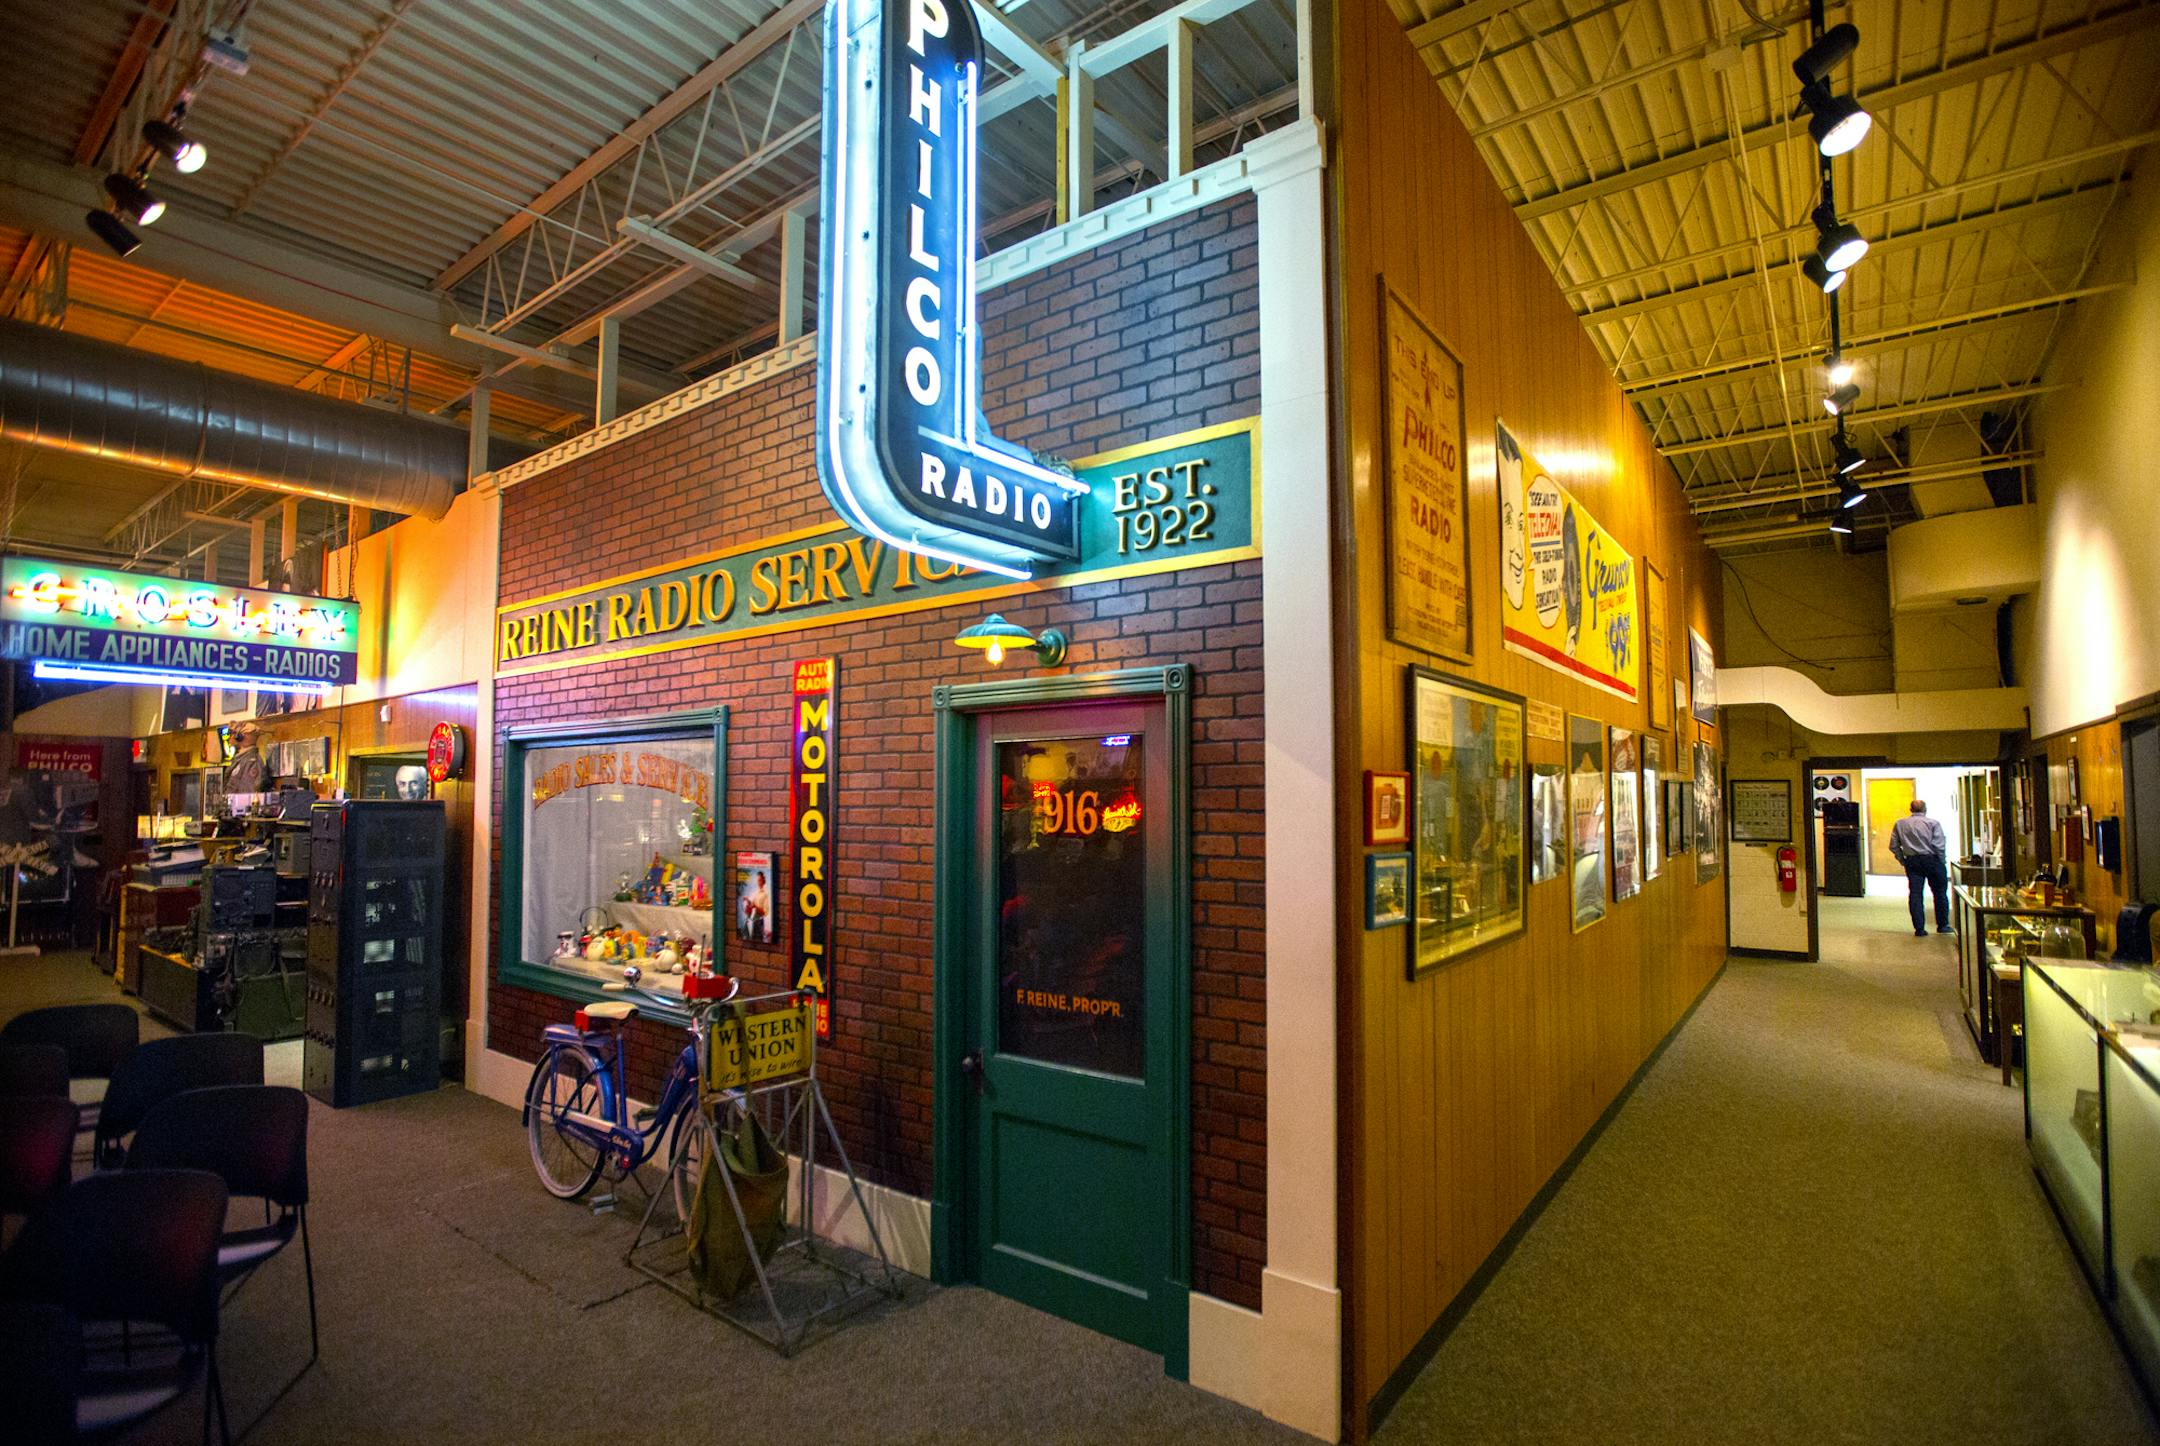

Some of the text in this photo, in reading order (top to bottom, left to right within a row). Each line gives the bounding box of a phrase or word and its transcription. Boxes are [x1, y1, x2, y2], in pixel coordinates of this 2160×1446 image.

[905, 0, 949, 406] PHILCO
[1403, 405, 1456, 472] PHILCO
[920, 451, 1051, 530] RADIO
[1112, 458, 1215, 514] EST.
[1114, 500, 1212, 554] 1922
[1410, 495, 1451, 544] RADIO
[27, 572, 348, 642] CROSLEY
[501, 600, 596, 662] REINE
[606, 568, 735, 642] RADIO
[7, 623, 91, 660] HOME
[30, 750, 91, 761] Here from
[574, 751, 618, 789] SALES
[620, 751, 633, 785] &
[636, 752, 709, 811] SERVICE
[1042, 789, 1099, 835] 916
[796, 699, 828, 994] MOTOROLA
[728, 1037, 795, 1067] UNION
[766, 1062, 778, 1074] to
